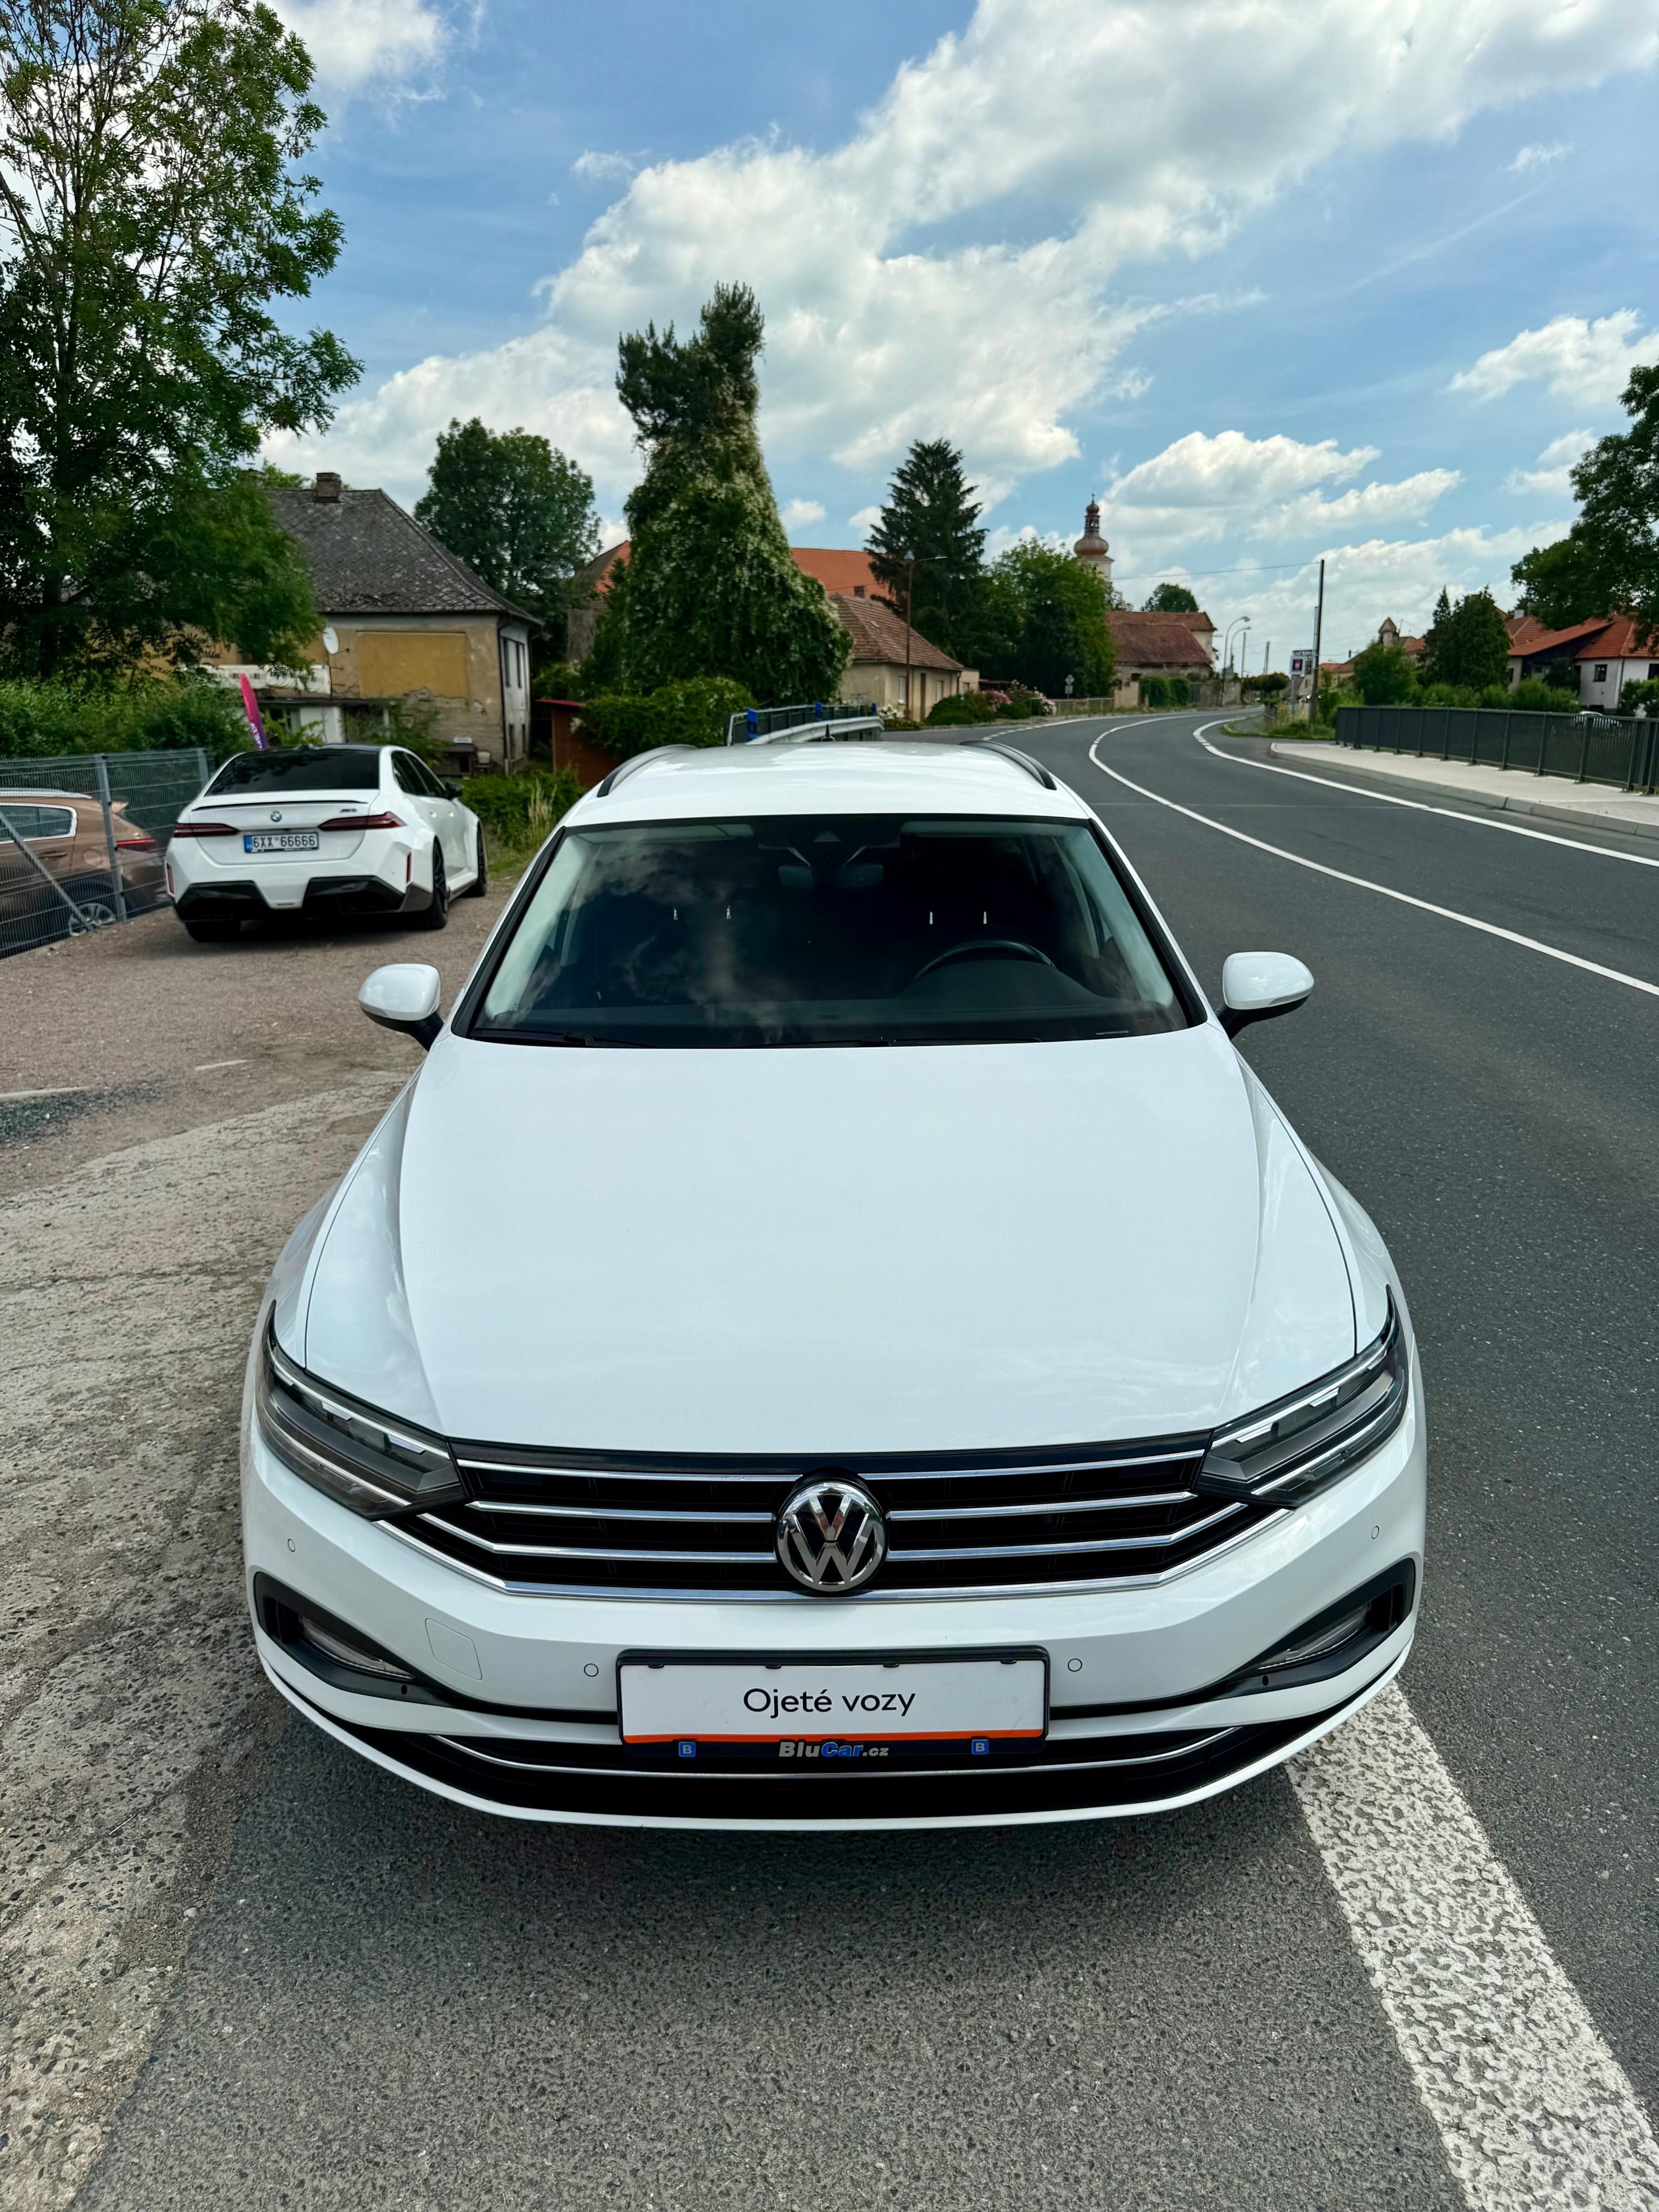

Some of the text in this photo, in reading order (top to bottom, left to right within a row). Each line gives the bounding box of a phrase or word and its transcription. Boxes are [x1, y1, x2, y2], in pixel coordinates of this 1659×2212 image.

[253, 835, 315, 848] 6XX 66666
[743, 1688, 916, 1719] Ojeté vozy
[683, 1745, 692, 1755] B
[779, 1742, 889, 1757] BluCar.cz
[975, 1743, 985, 1752] B
